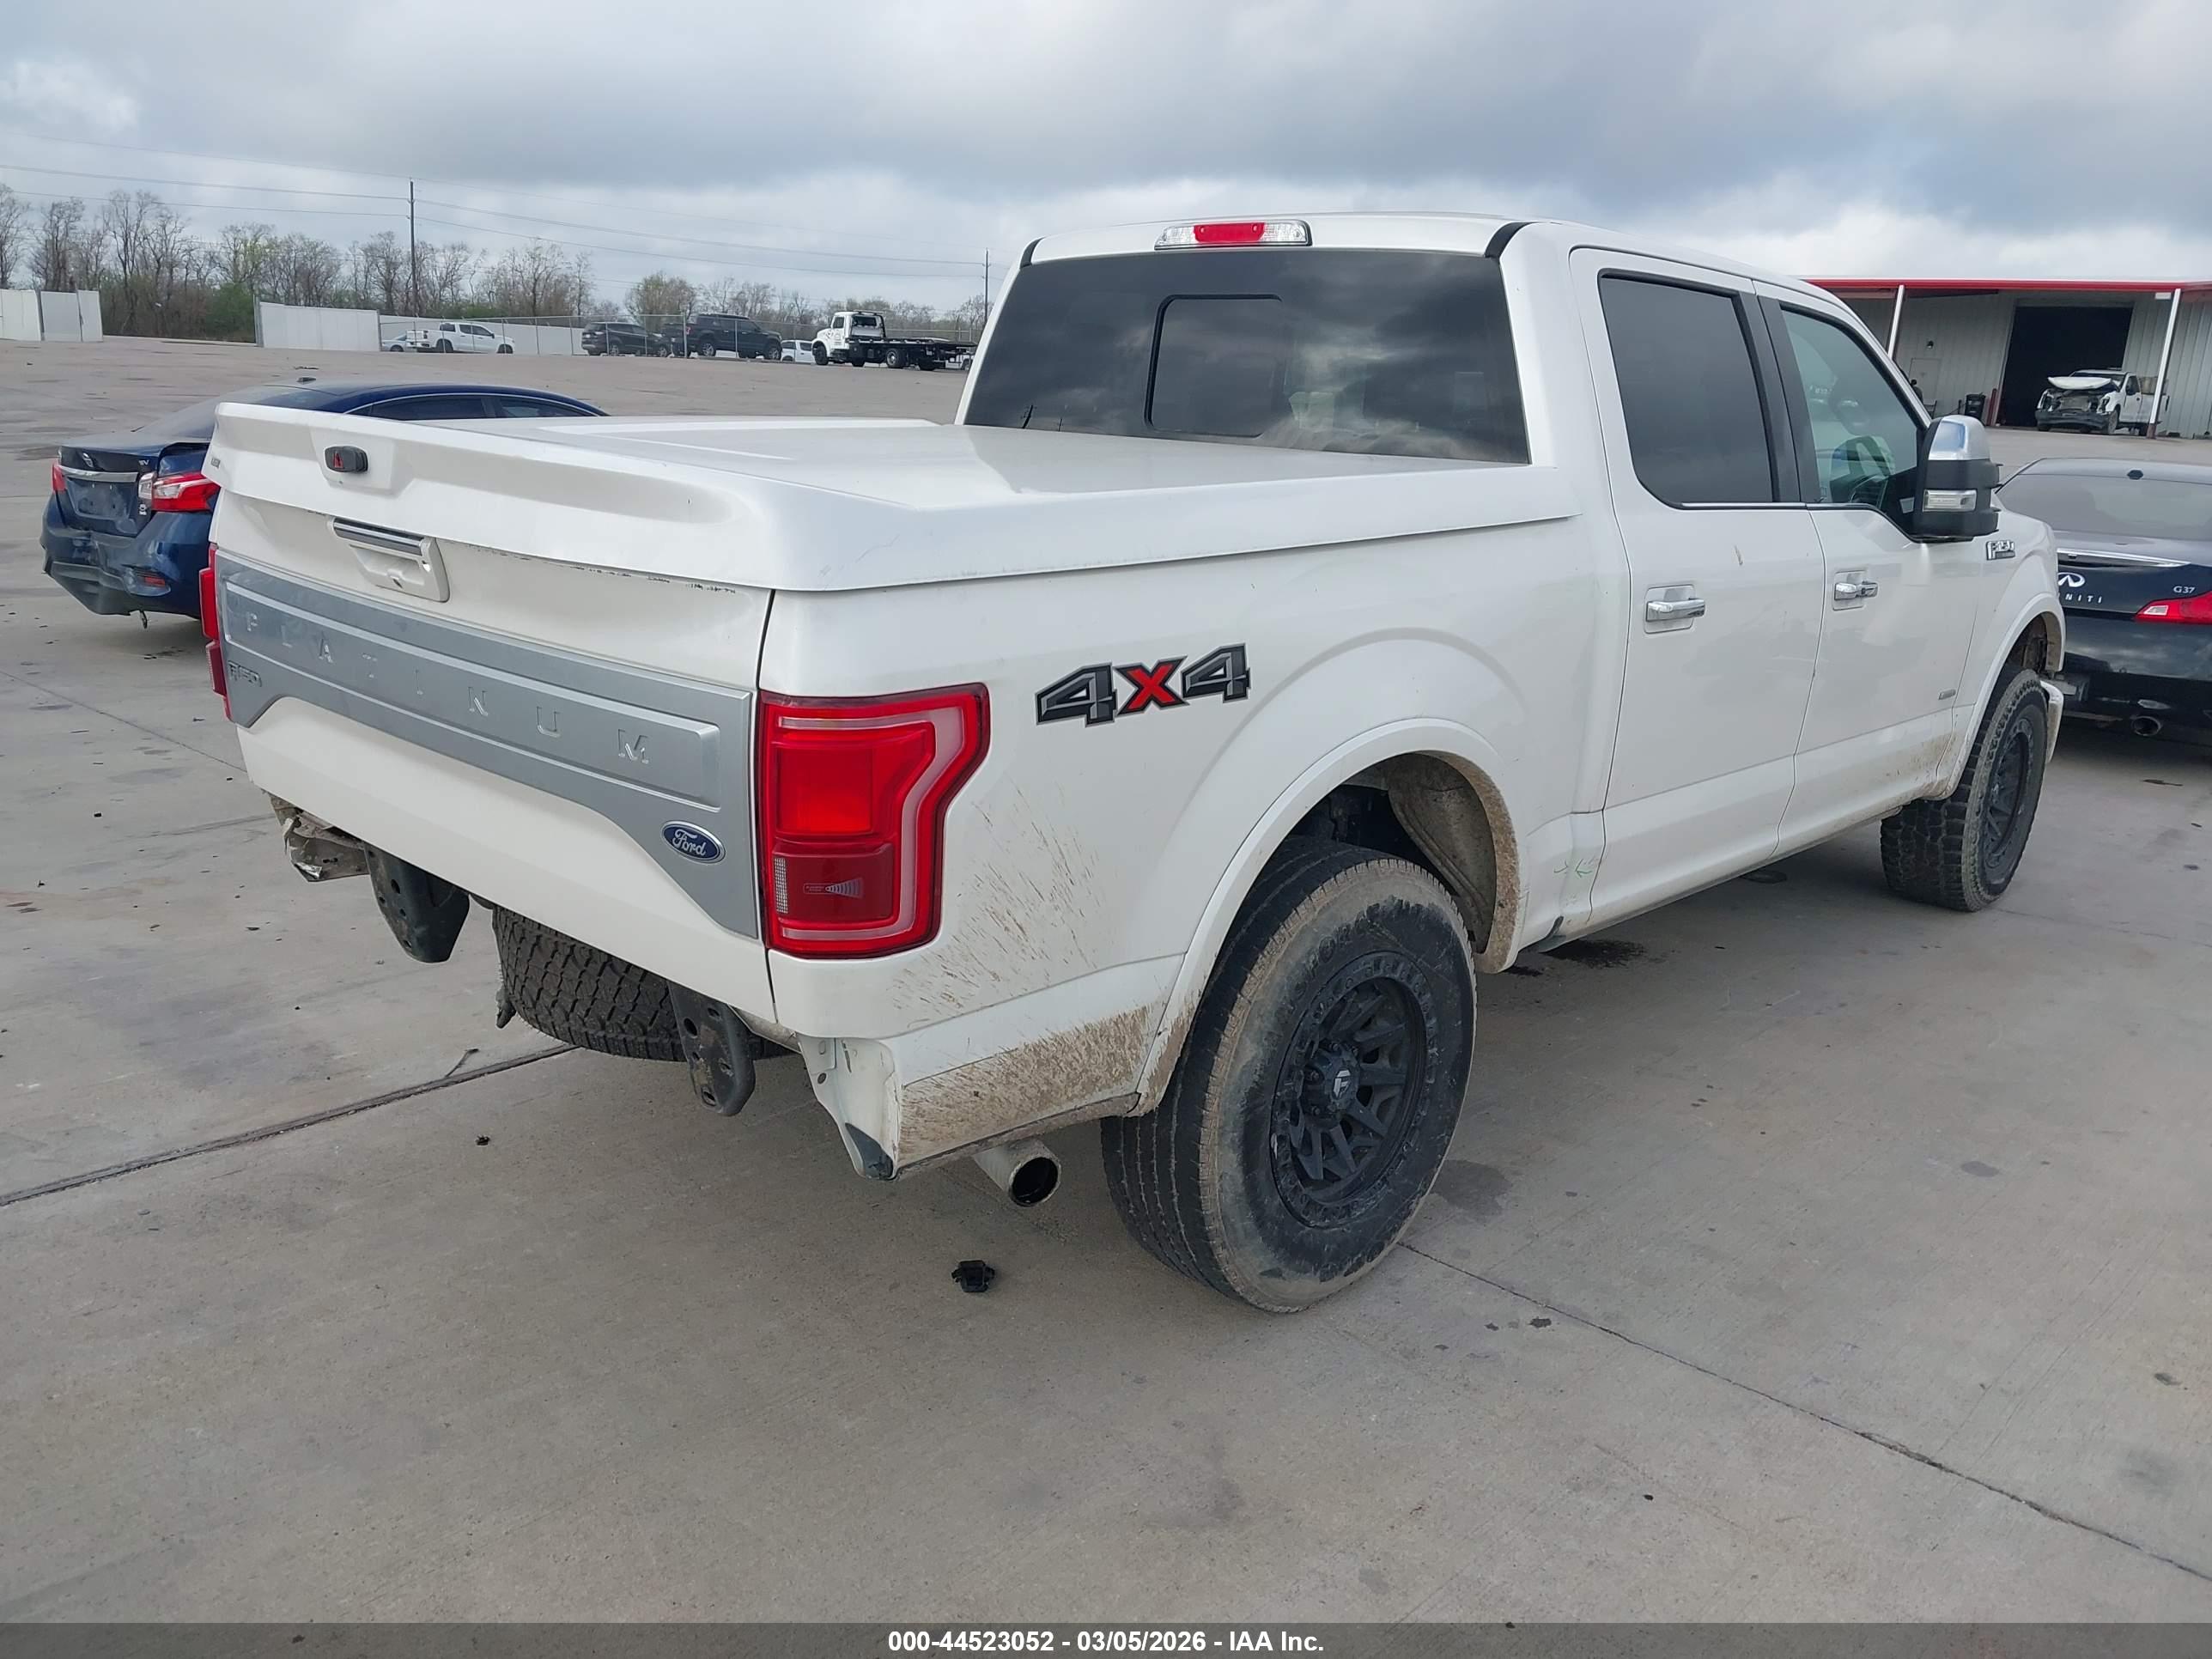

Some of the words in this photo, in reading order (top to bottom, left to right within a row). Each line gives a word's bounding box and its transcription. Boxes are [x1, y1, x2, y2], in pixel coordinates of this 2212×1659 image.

[2057, 592, 2102, 604] NITI
[2173, 586, 2196, 594] G37
[246, 611, 650, 764] PLATINUM
[672, 829, 707, 856] Ford
